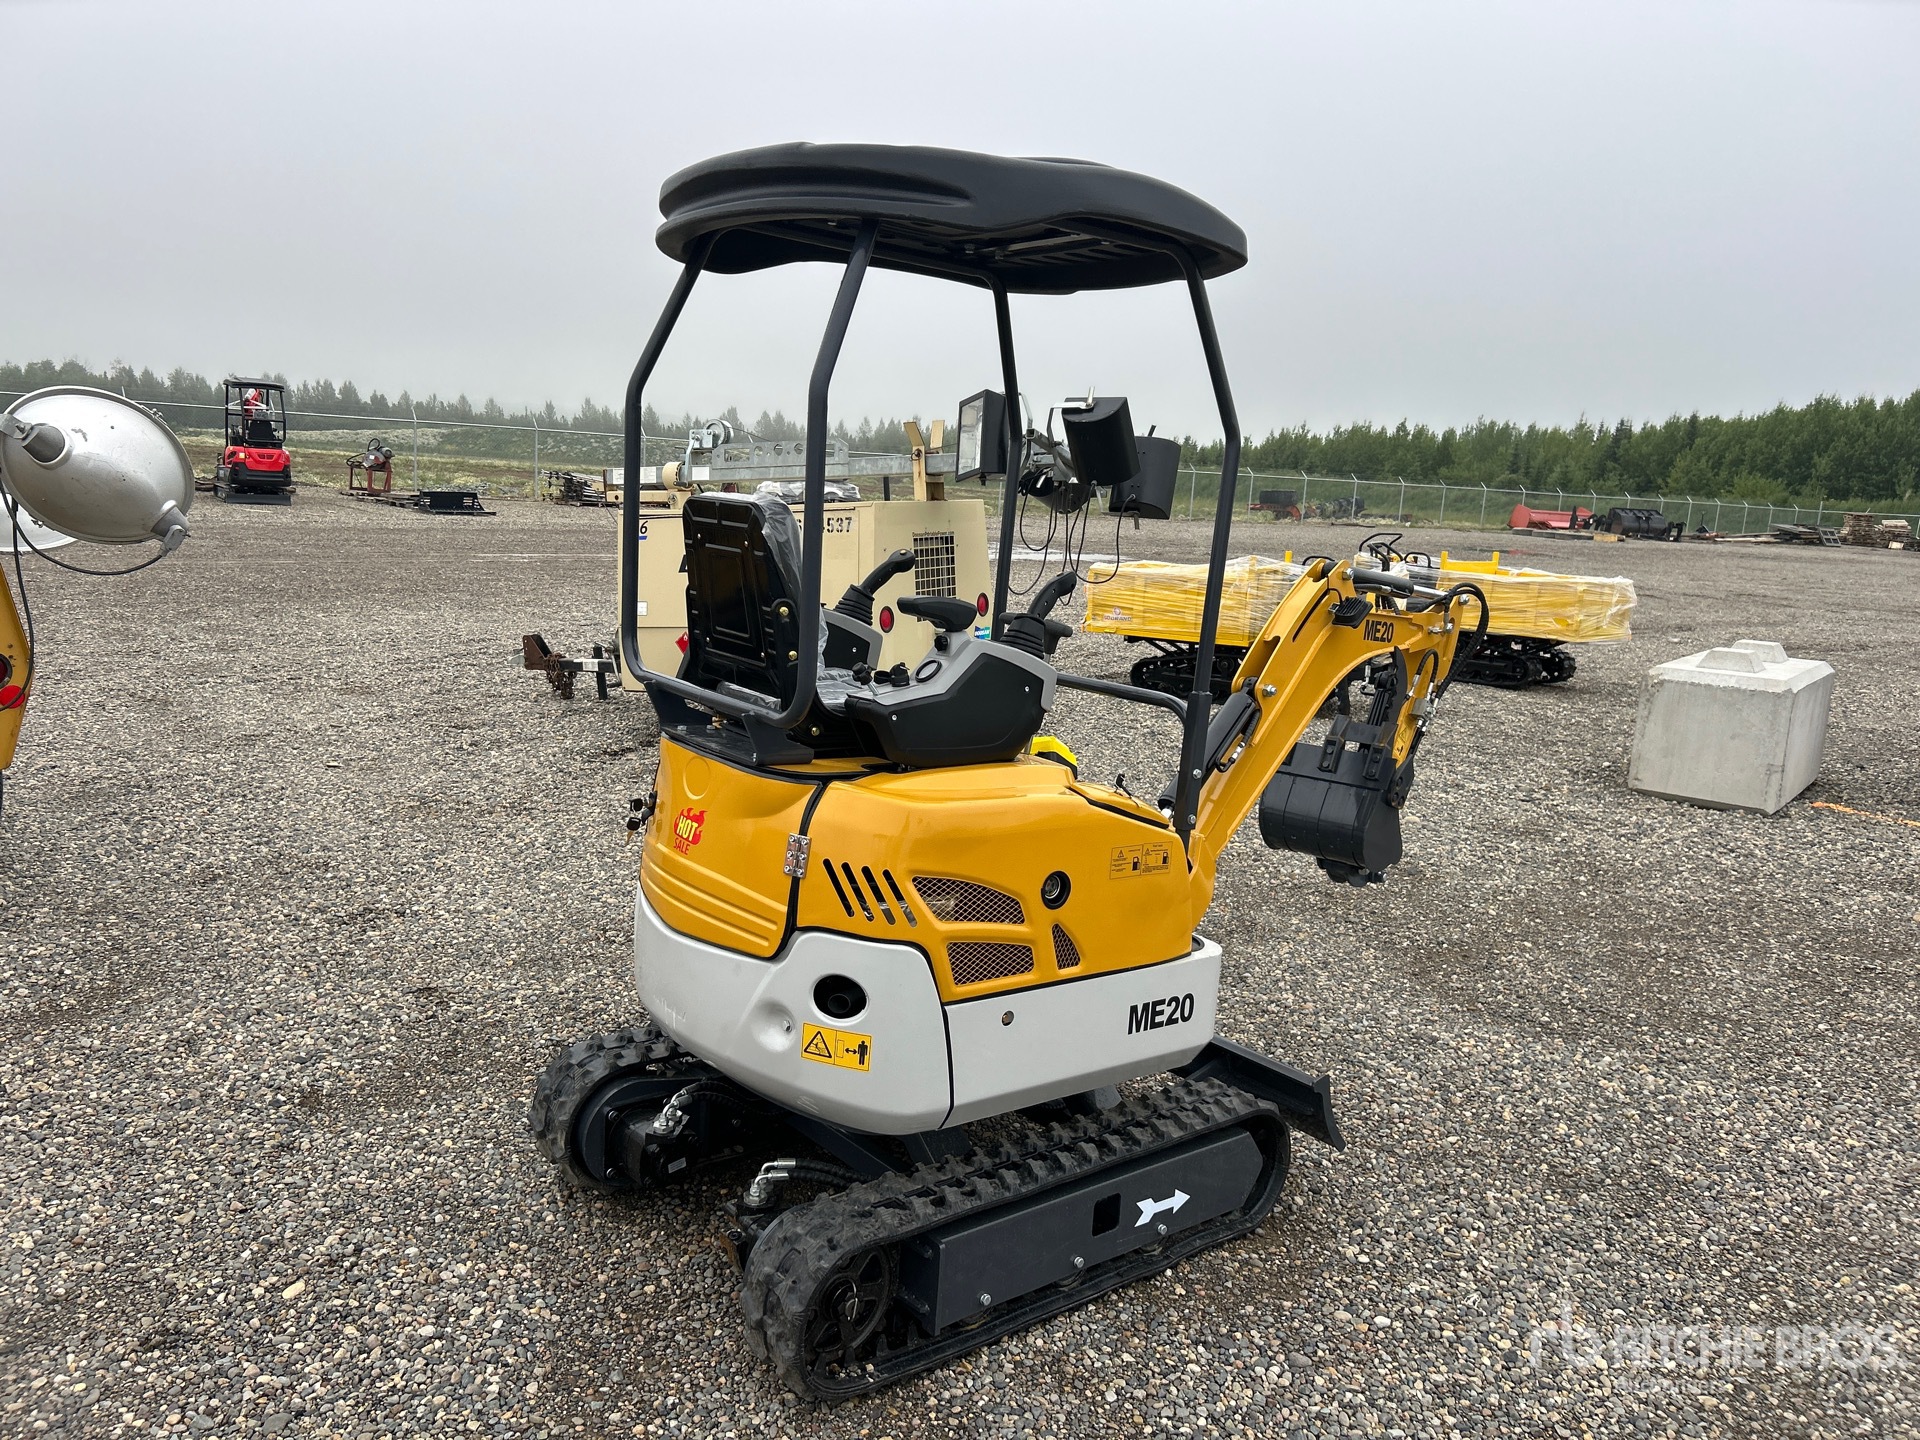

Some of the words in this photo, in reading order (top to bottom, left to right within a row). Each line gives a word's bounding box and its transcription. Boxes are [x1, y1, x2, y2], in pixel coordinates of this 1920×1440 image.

[823, 516, 852, 533] 537
[1363, 619, 1394, 643] ME20
[676, 815, 699, 841] HOT
[673, 837, 690, 855] SALE
[1127, 992, 1195, 1035] ME20
